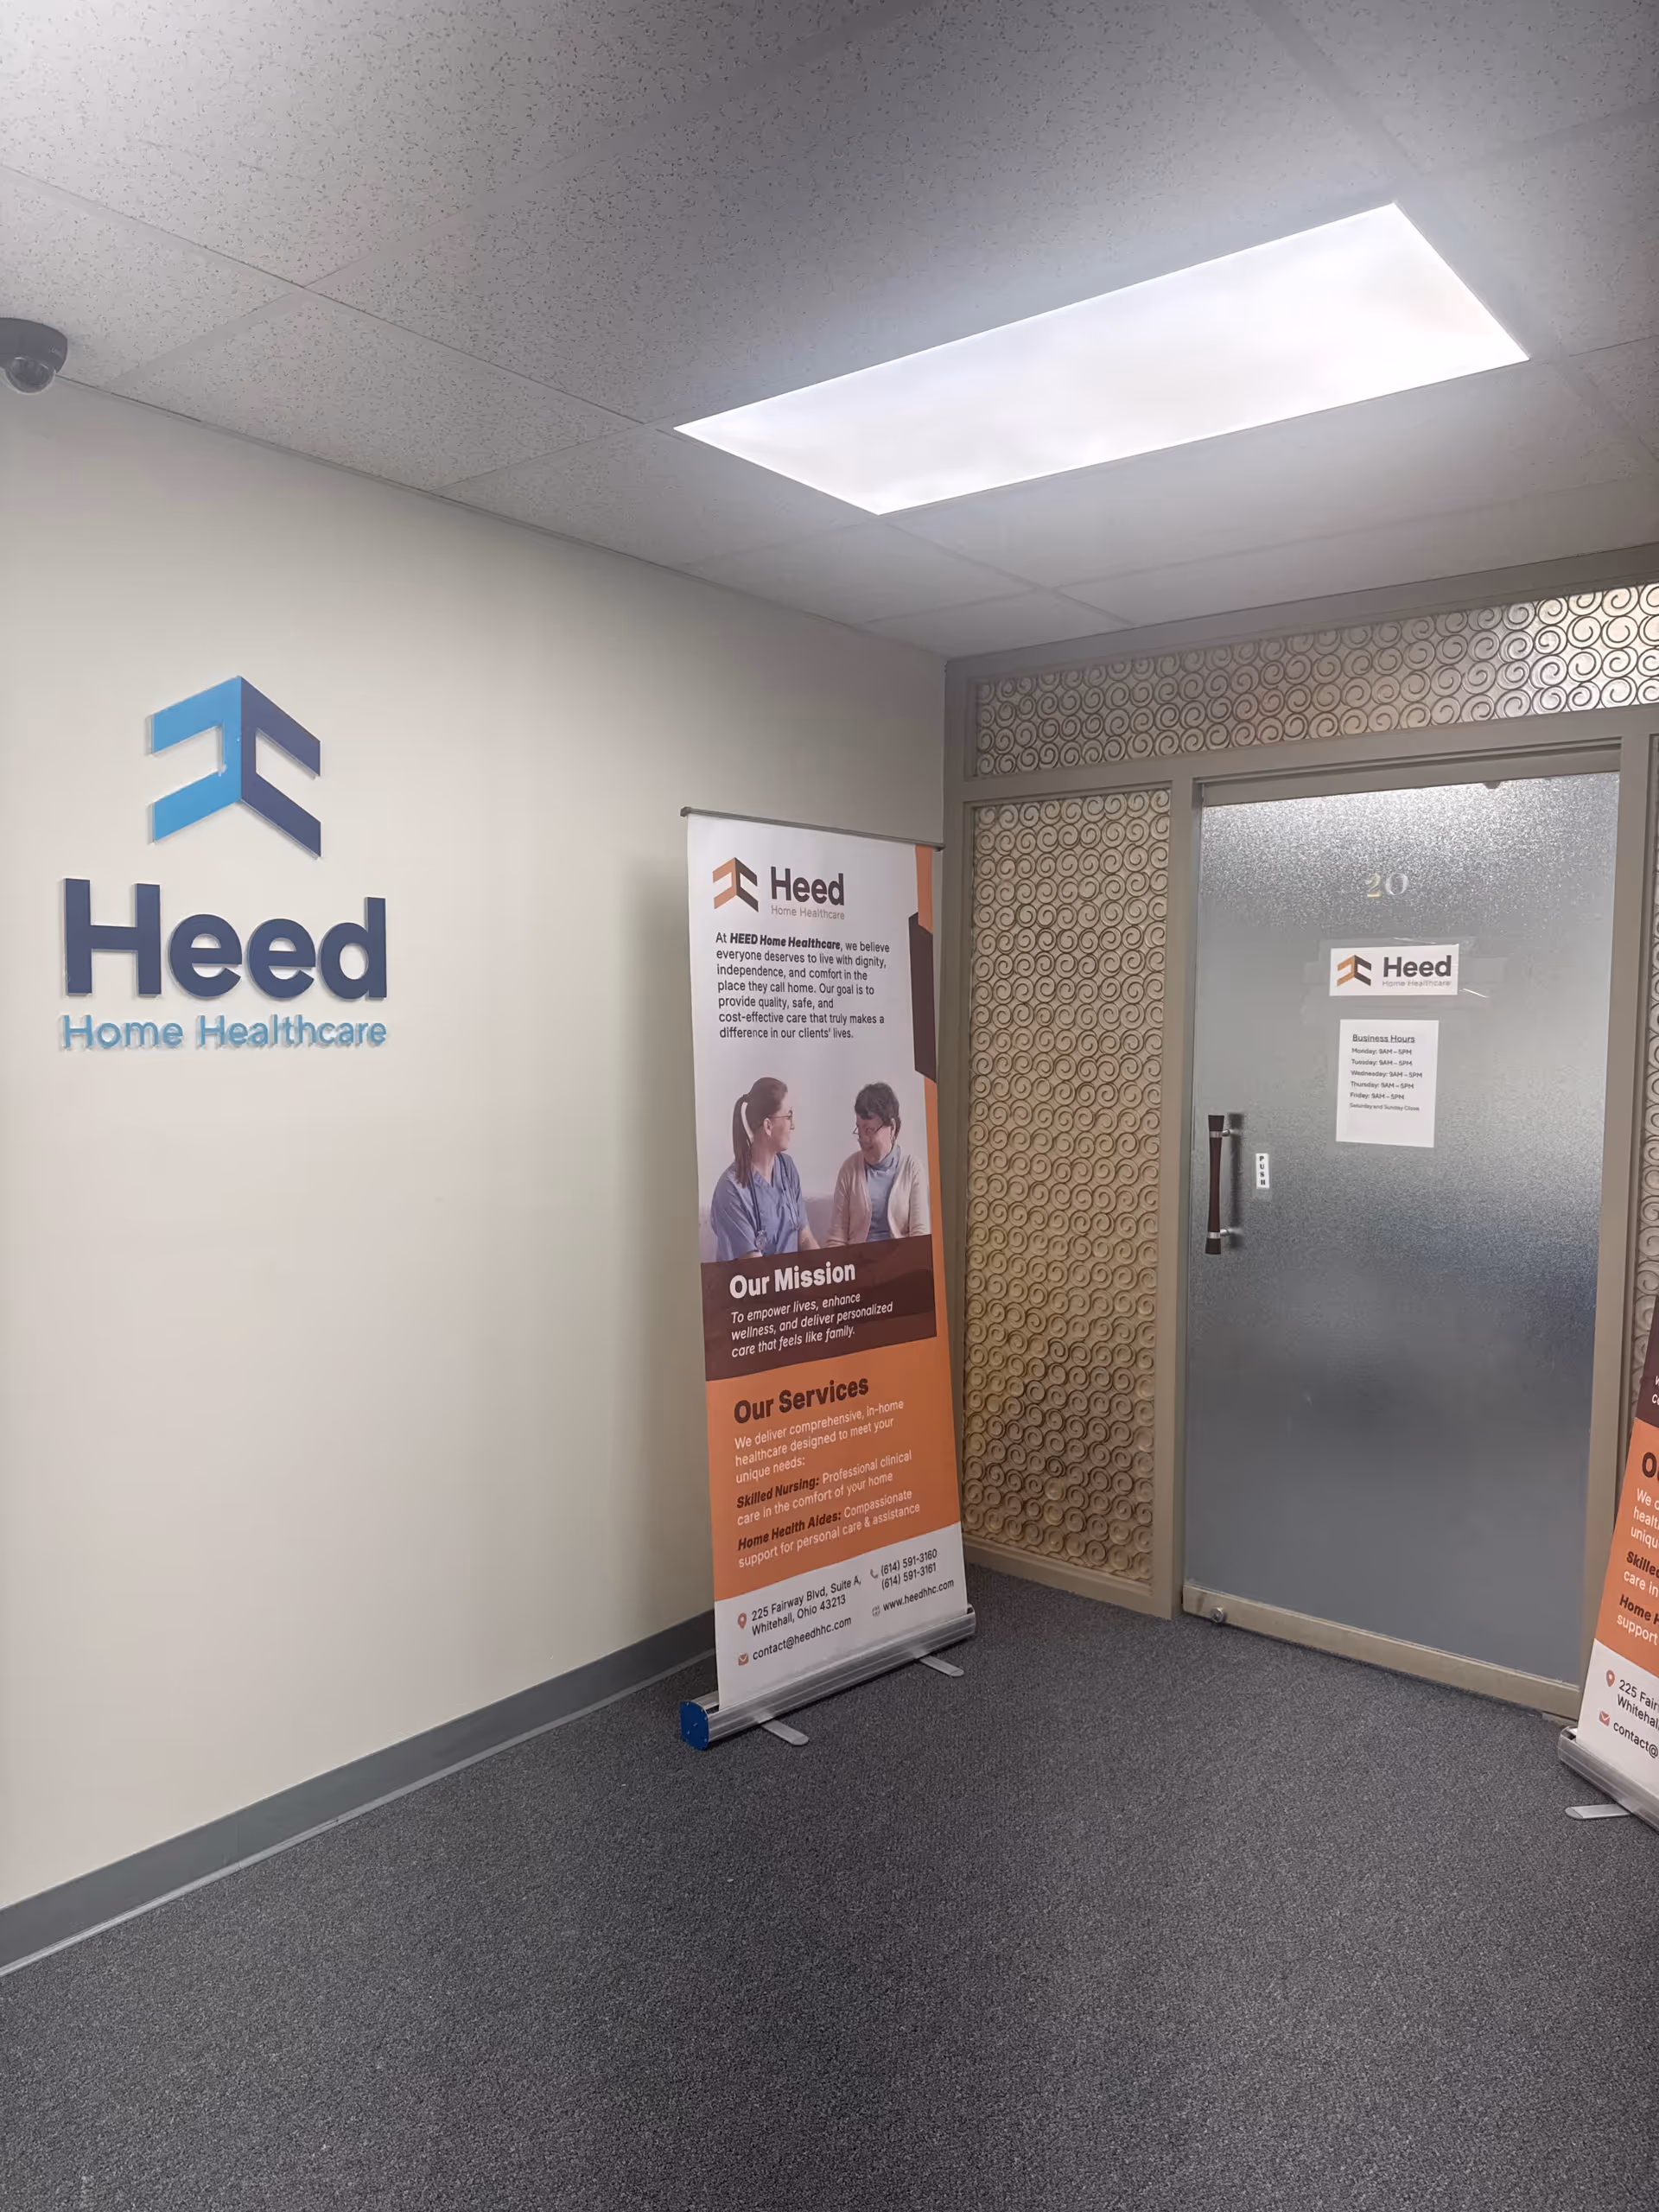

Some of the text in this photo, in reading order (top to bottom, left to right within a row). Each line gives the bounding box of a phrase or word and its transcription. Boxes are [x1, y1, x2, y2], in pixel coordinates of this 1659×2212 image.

[771, 866, 844, 906] Heed
[771, 905, 844, 920] Home Healthcare
[63, 878, 387, 1001] Heed
[715, 932, 890, 953] At HEED Home Healthcare, we believe
[716, 950, 887, 969] everyone deserves to live with dignity,
[717, 963, 868, 981] independence, and comfort in the
[1383, 955, 1452, 977] Heed
[718, 980, 874, 996] place they call home. Our goal is to
[718, 995, 834, 1010] provide quality, safe, and
[61, 1014, 387, 1050] Home Healthcare
[719, 1011, 885, 1026] cost-effective care that truly makes a
[719, 1027, 768, 1038] difference
[771, 1027, 778, 1038] in
[780, 1029, 796, 1038] our
[833, 1027, 854, 1039] lives.
[1352, 1033, 1415, 1044] Business Hours
[729, 1261, 855, 1300] Our Mission
[731, 1293, 861, 1324] To empower lives, enhance
[731, 1300, 893, 1341] wellness, and deliver personalized
[732, 1324, 855, 1358] care that feels like family.
[734, 1377, 869, 1424] Our Services
[734, 1400, 904, 1450] We deliver comprehensive, in-home
[735, 1417, 894, 1467] healthcare designed to meet your
[736, 1456, 805, 1484] unique needs:
[736, 1450, 912, 1509] Skilled Nursing: Professional clinical
[737, 1471, 893, 1526] care in the comfort of your home
[1637, 1488, 1652, 1507] We
[738, 1489, 912, 1551] Home Health Aides: Compassionate
[739, 1503, 920, 1568] support for personal care & assistance
[880, 1548, 938, 1577] (614) 591-3160
[881, 1562, 937, 1591] (614) 591-3161
[752, 1574, 861, 1622] 225 Fairway Blvd, Suite A,
[883, 1578, 955, 1612] www.heedhhc.com
[1624, 1571, 1659, 1598] care in
[752, 1594, 846, 1637] Whitehall, Ohio 43213
[1619, 1594, 1651, 1622] Home
[753, 1617, 852, 1661] contact@heedhhc.com
[1617, 1614, 1659, 1646] support
[1618, 1679, 1637, 1698] 225
